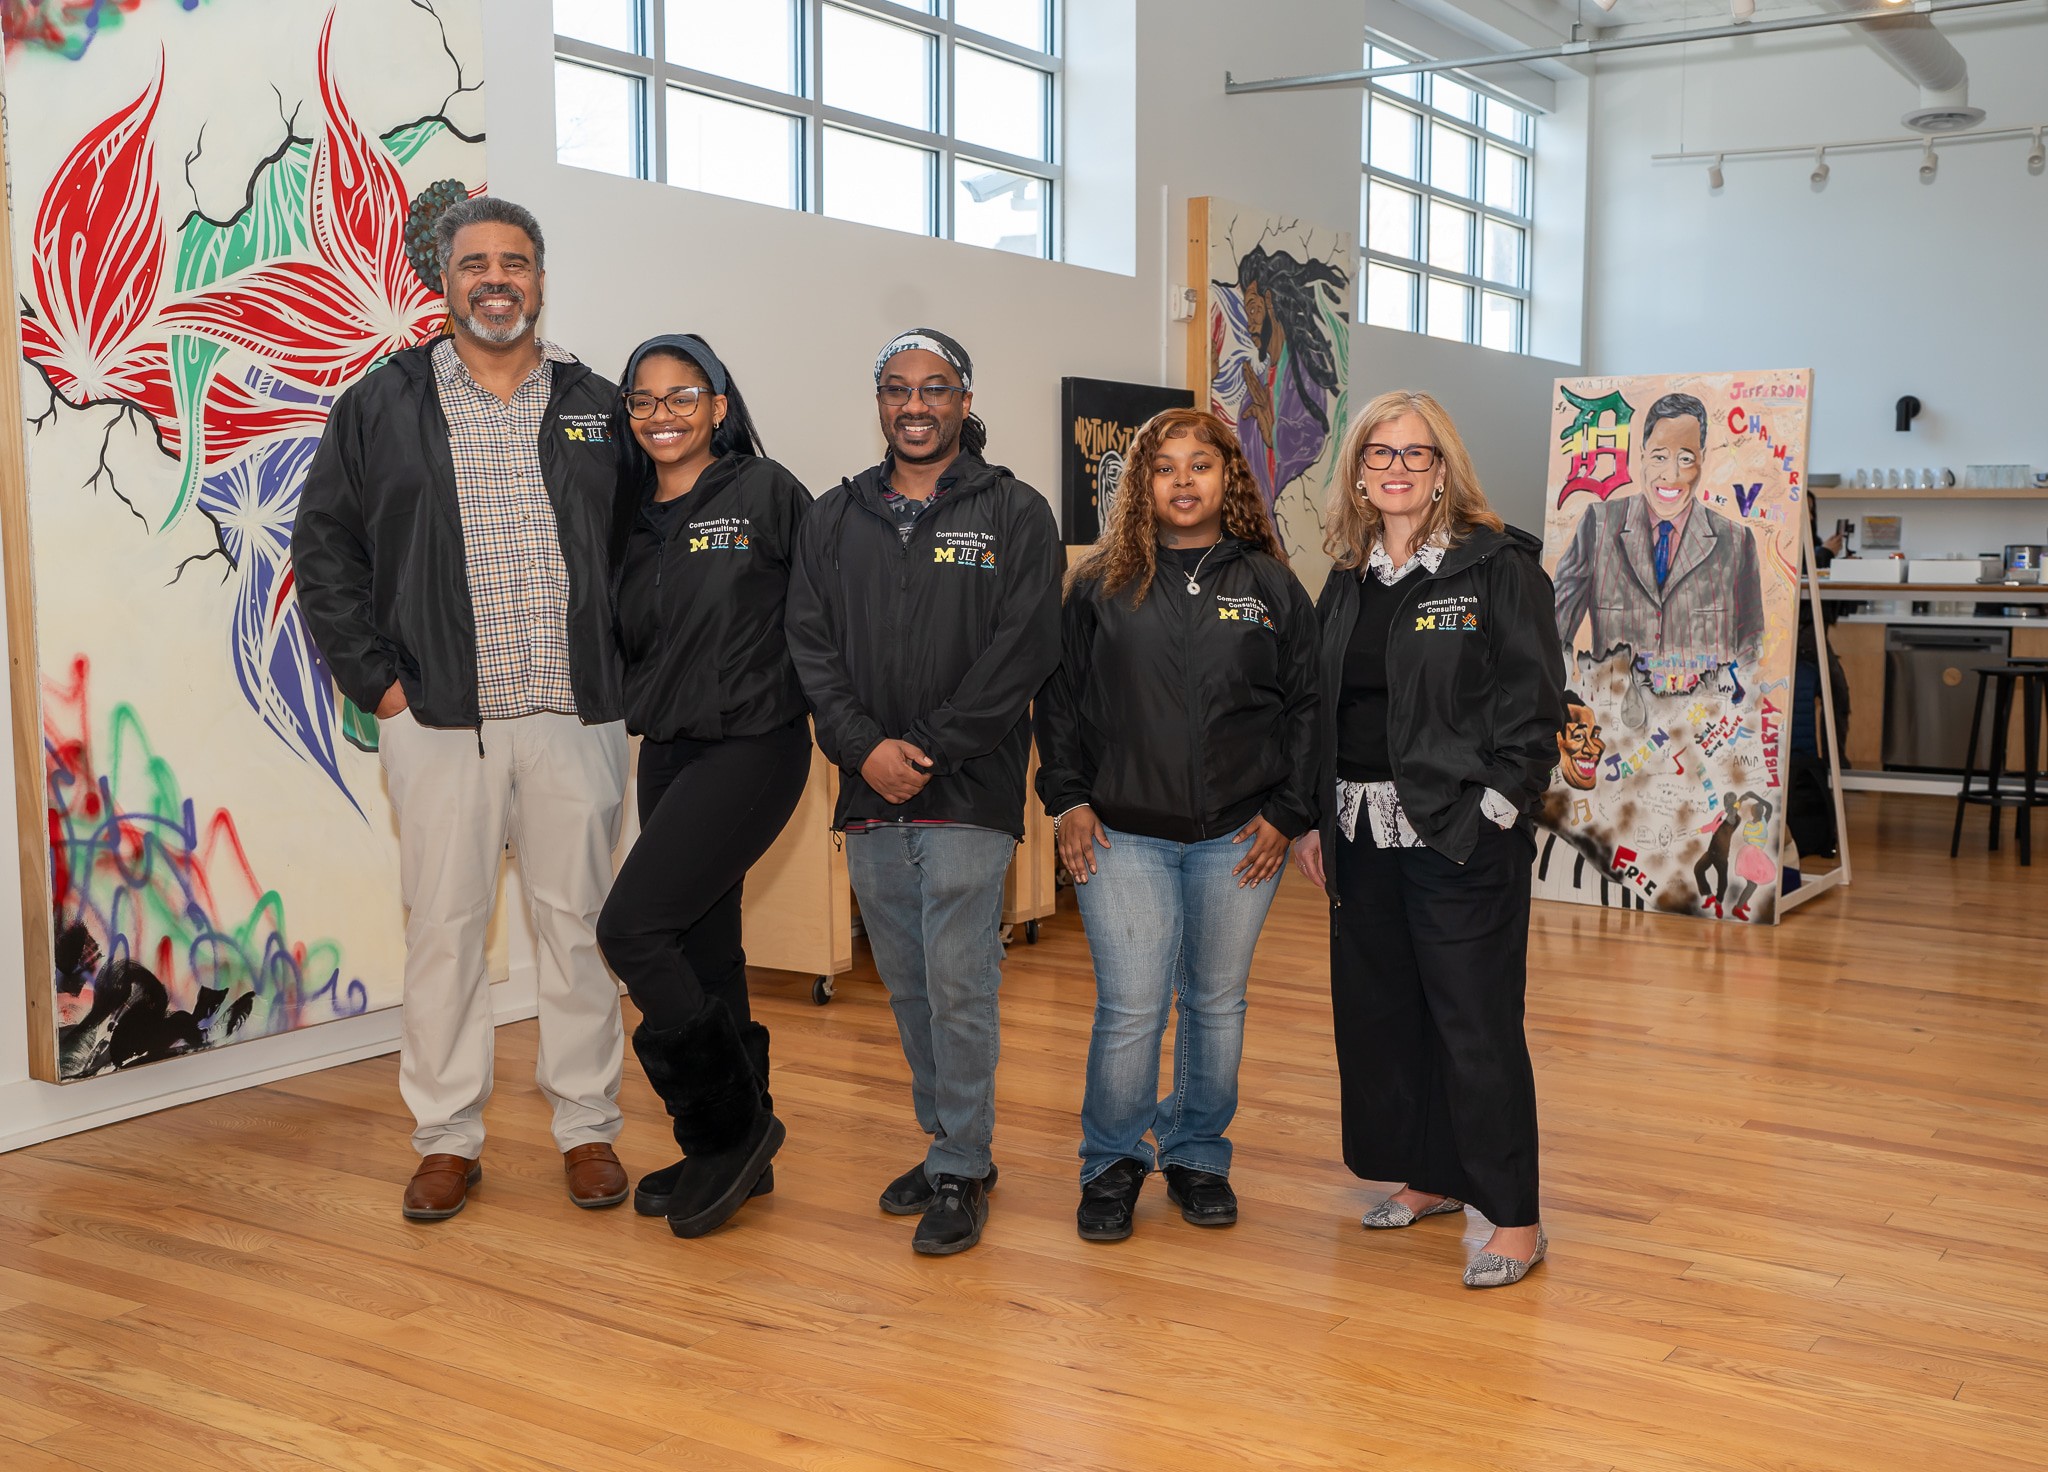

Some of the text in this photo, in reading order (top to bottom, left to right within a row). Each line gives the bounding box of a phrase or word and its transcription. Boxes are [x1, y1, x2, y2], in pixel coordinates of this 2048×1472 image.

[1730, 382, 1807, 400] JEFFERSON
[558, 413, 597, 421] Community
[571, 420, 607, 428] Consulting
[564, 427, 586, 442] M
[1728, 406, 1800, 502] CHALMERS
[689, 517, 730, 529] Community
[699, 525, 738, 535] Consulting
[935, 531, 996, 541] Community Tec
[689, 535, 709, 553] M
[946, 538, 987, 550] Consulting
[933, 547, 956, 563] M
[1216, 594, 1257, 604] Community
[1417, 595, 1478, 609] Community Tech
[1217, 607, 1240, 620] M
[1426, 604, 1466, 614] Consulting
[1414, 614, 1436, 632] M
[1761, 697, 1782, 787] LIBERTY
[1604, 726, 1670, 782] JAZZIN
